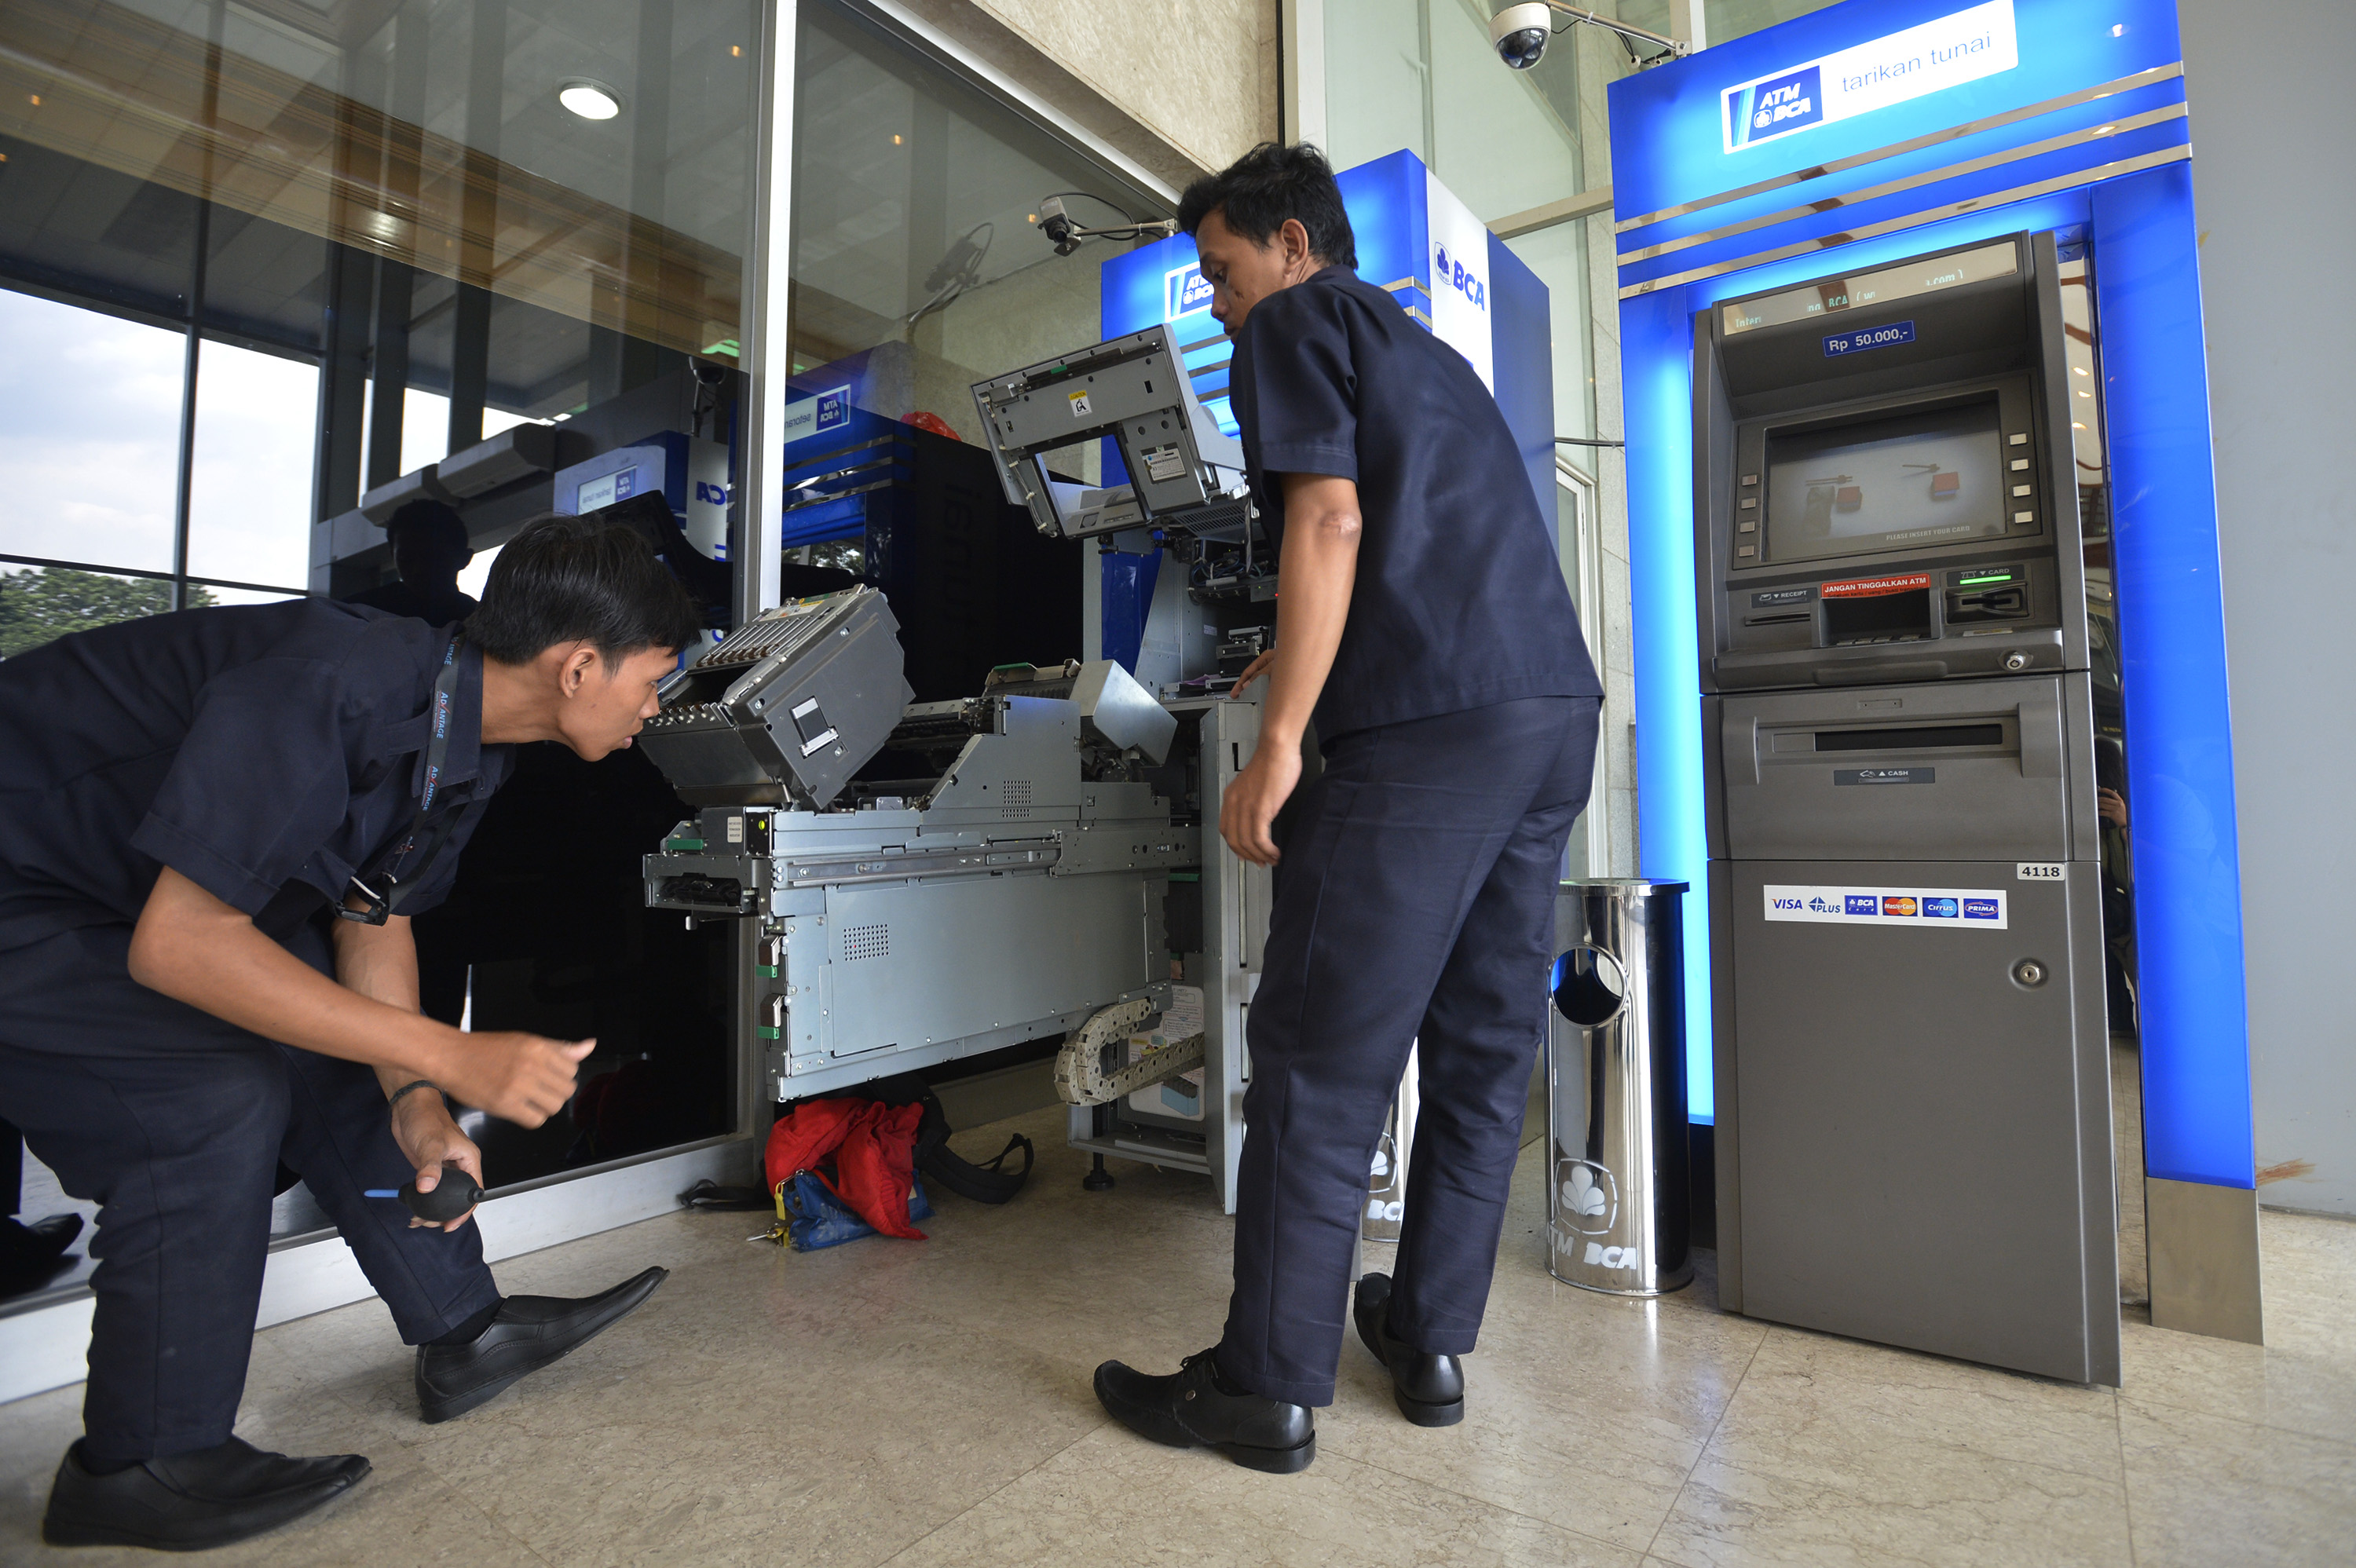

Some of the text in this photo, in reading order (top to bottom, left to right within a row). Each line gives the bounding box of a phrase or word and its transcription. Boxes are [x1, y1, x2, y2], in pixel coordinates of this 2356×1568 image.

[1842, 31, 1990, 92] tarikan tunai
[1759, 82, 1801, 110] ATM
[1772, 97, 1811, 122] BCA
[1453, 259, 1485, 312] BCA
[1829, 329, 1908, 352] Rp 50.000,-
[1824, 584, 1856, 593] JANGAN
[1857, 580, 1908, 590] TINGGALKAN
[2022, 867, 2060, 877] 4118
[1771, 898, 1803, 909] VISA
[1816, 905, 1841, 913] PLUS
[1583, 1242, 1637, 1270] BCA
